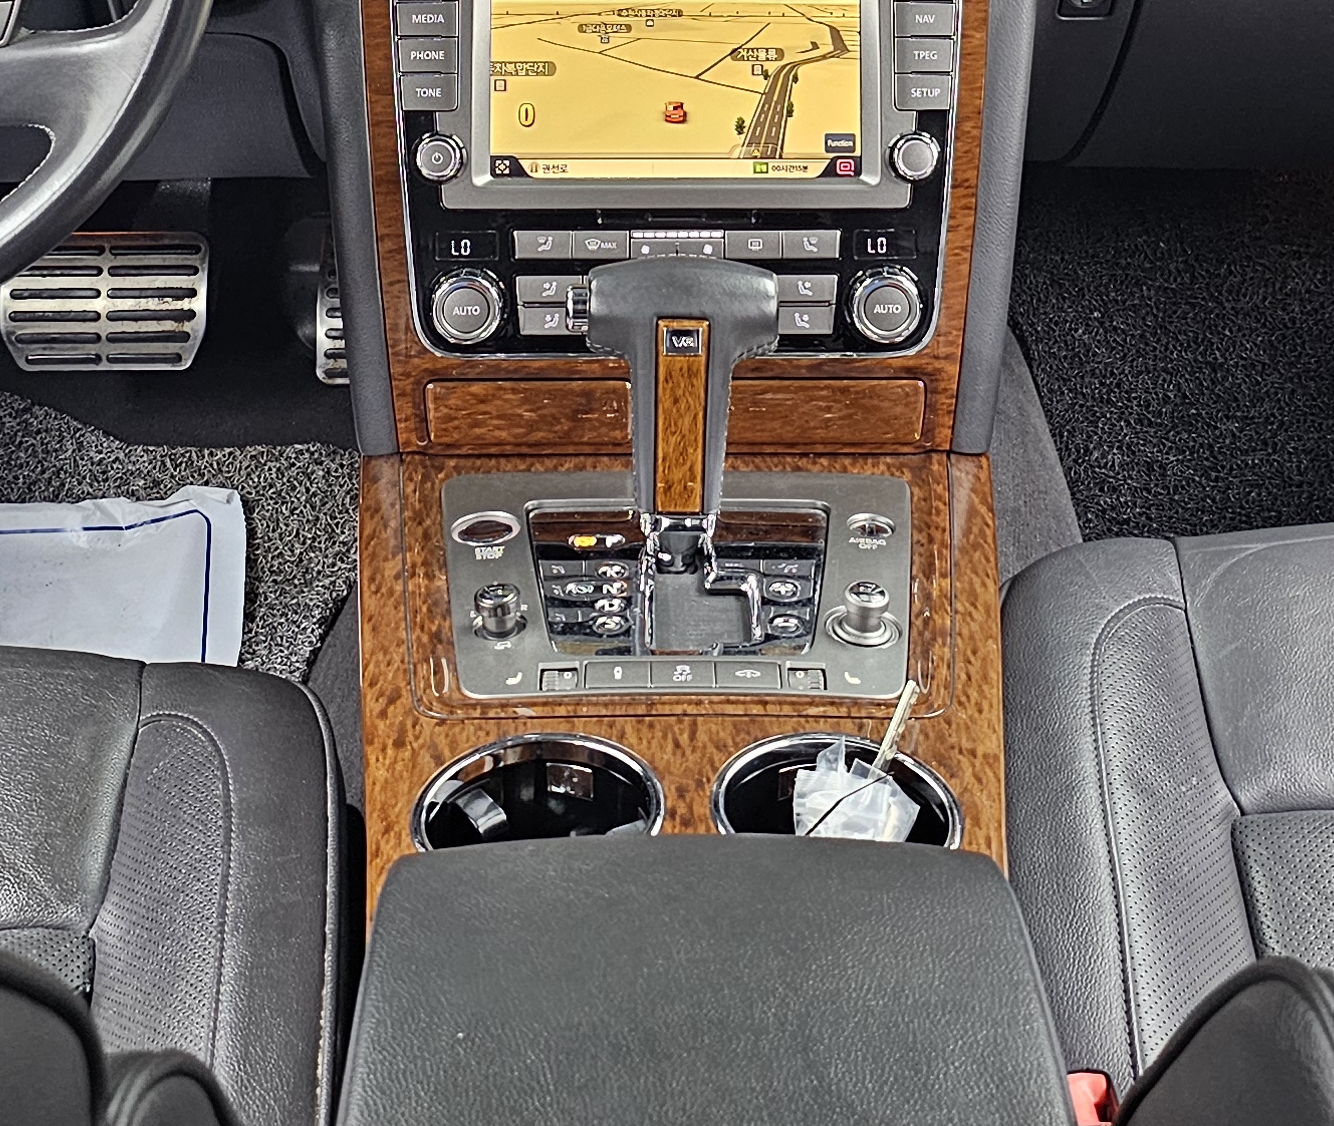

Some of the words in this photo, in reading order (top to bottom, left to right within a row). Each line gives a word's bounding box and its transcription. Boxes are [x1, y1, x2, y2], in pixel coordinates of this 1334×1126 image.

[411, 14, 445, 24] MEDIA
[915, 15, 936, 24] NAV
[410, 50, 445, 60] PHONE
[913, 50, 938, 60] TPEG
[415, 88, 442, 97] TONE
[910, 88, 941, 98] SETUP
[518, 103, 536, 128] 0
[827, 139, 854, 148] Function
[451, 239, 471, 256] LO
[600, 242, 618, 250] MAX
[867, 237, 887, 254] LO
[452, 306, 481, 316] AUTO
[873, 304, 902, 314] AUTO
[474, 546, 505, 554] START
[673, 674, 693, 682] OFF
